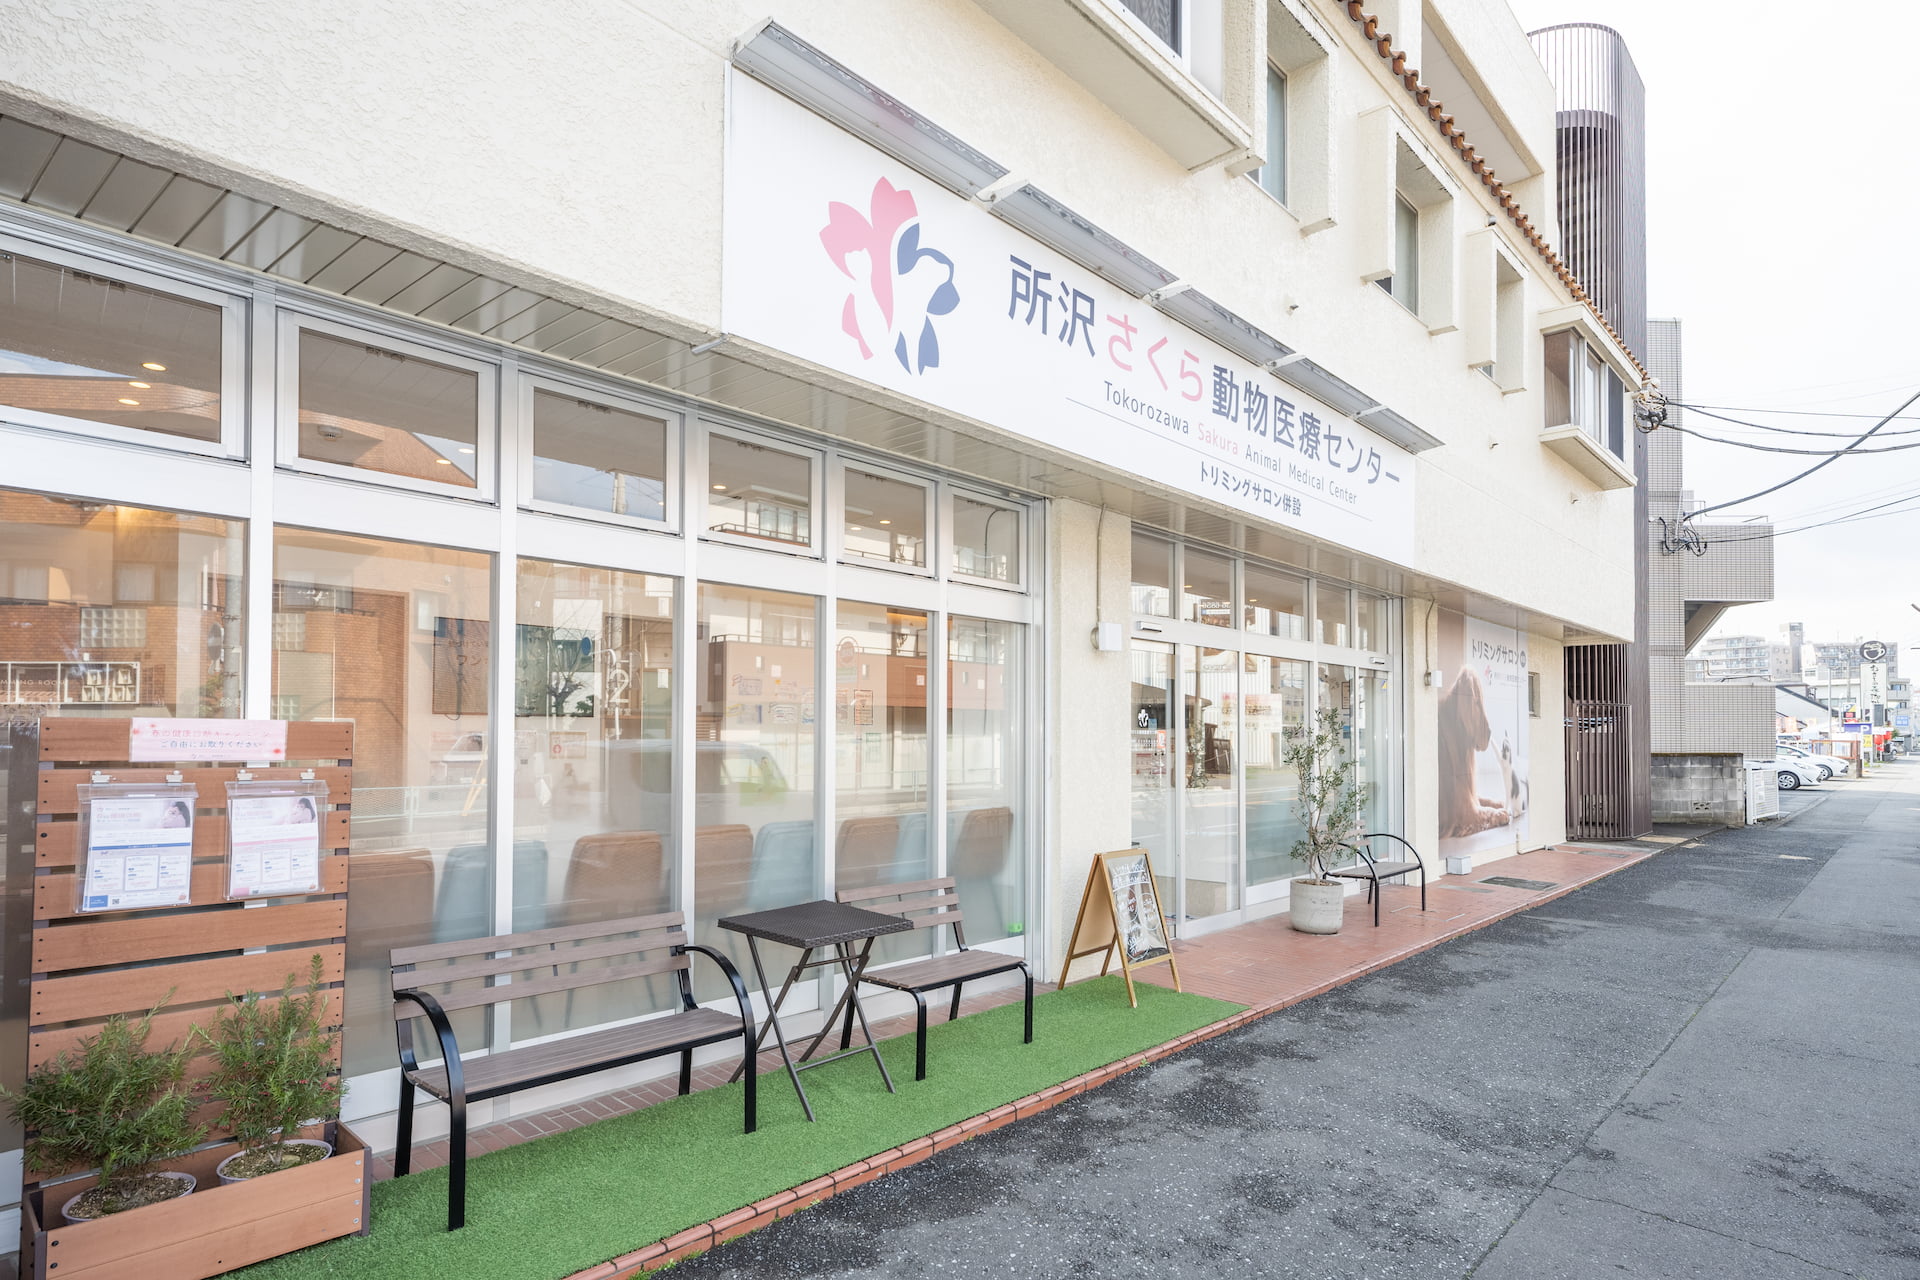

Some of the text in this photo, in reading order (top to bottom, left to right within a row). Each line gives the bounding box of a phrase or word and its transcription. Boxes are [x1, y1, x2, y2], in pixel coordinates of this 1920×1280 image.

[1008, 254, 1400, 484] 所沢さくら動物医療センター
[1104, 380, 1357, 505] Tokorozawa Sakura Animal Medical Center
[1201, 460, 1302, 517] トリミングサロン併設
[1472, 638, 1520, 665] トリミングサロン
[609, 669, 630, 703] 2
[1860, 725, 1870, 734] P
